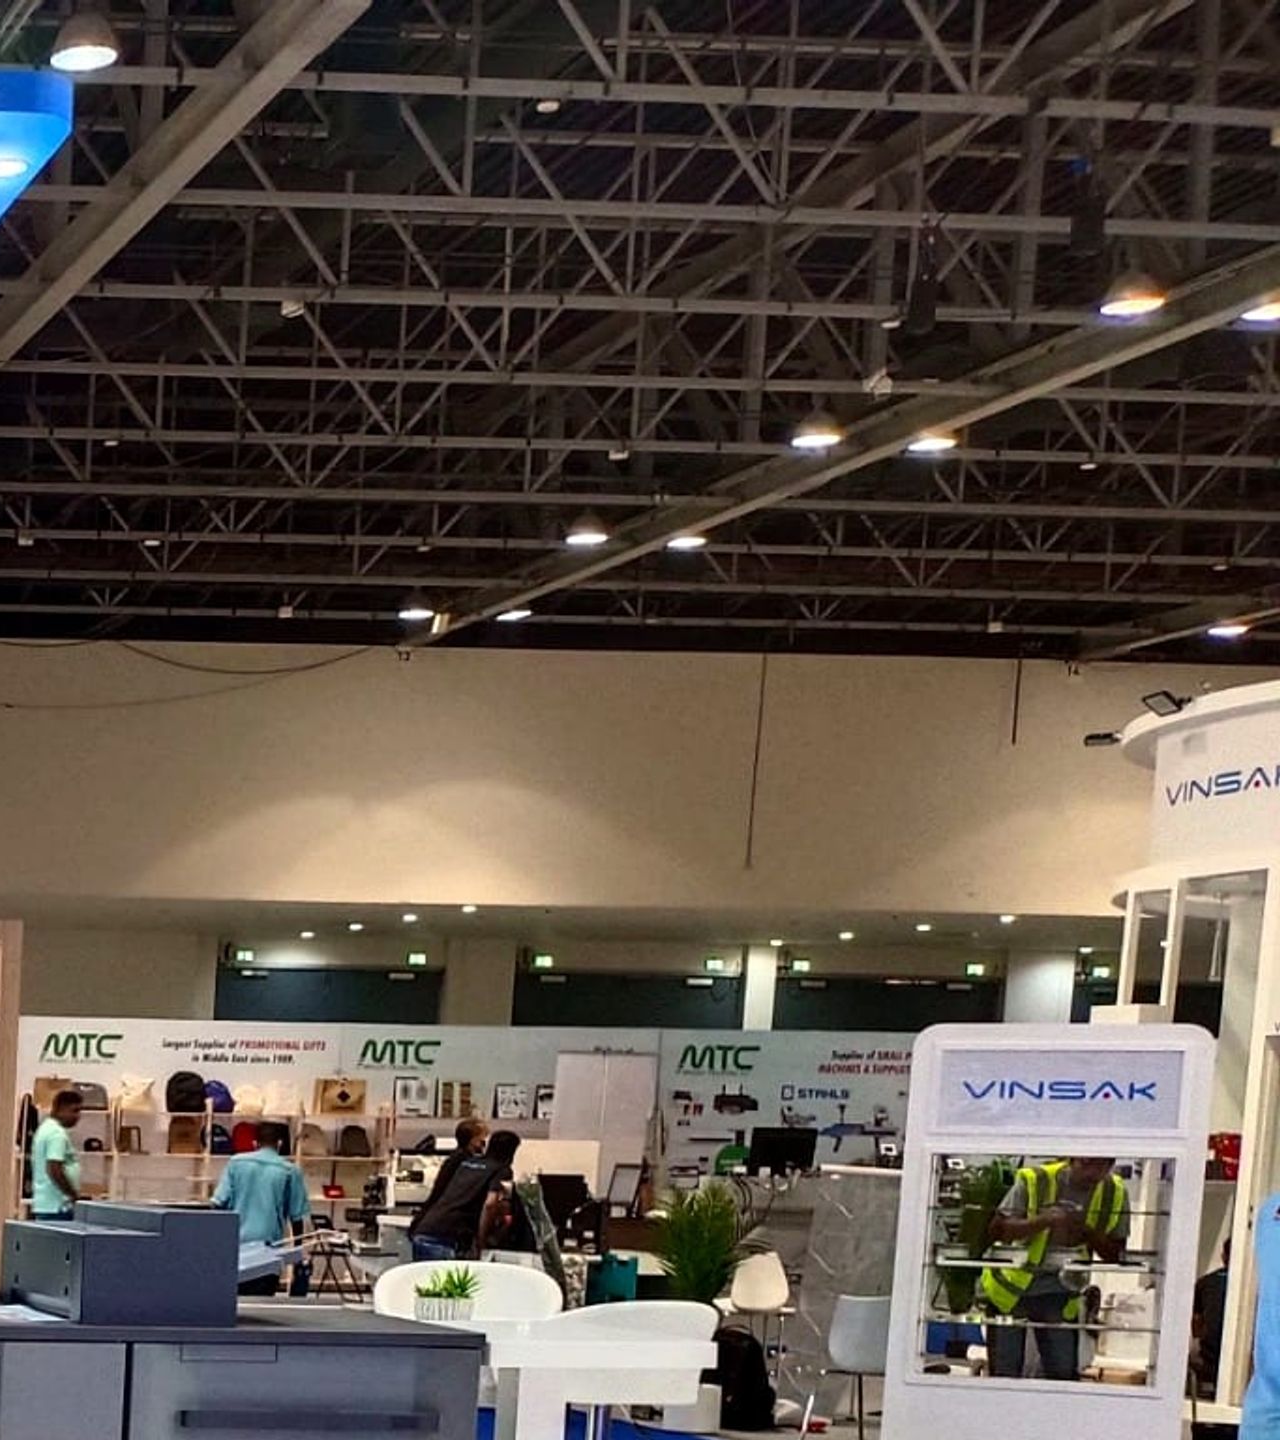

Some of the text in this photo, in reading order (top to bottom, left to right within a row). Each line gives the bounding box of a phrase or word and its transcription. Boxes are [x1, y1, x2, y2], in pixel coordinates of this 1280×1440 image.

[41, 1033, 124, 1060] MTC
[239, 1040, 300, 1051] PROMOTIONAL
[359, 1039, 441, 1065] MTC
[678, 1044, 761, 1070] MTC
[963, 1081, 1157, 1101] VINSAK
